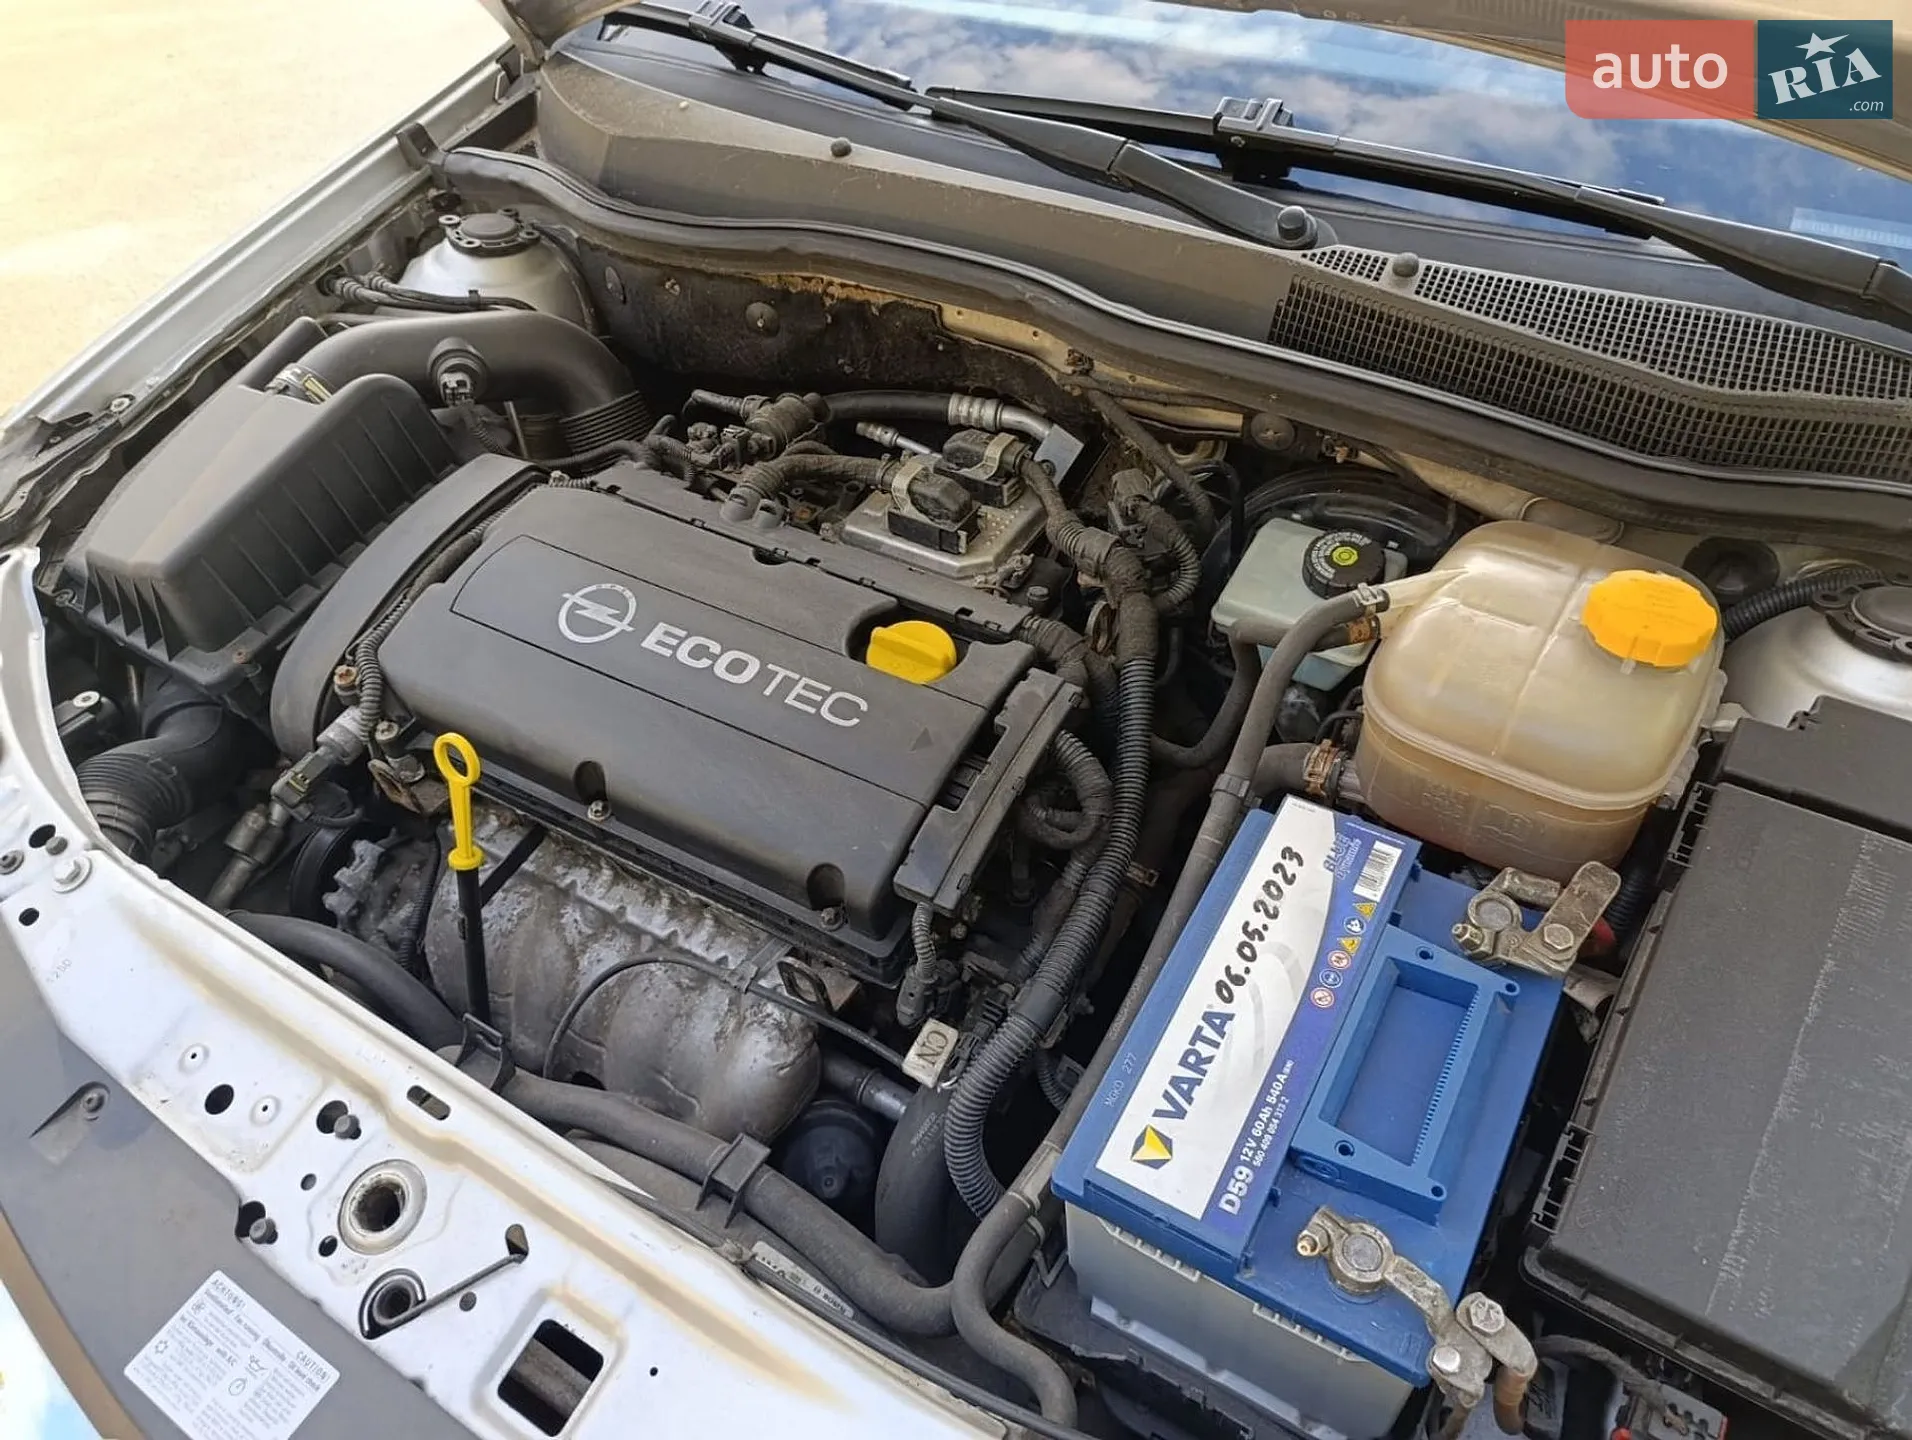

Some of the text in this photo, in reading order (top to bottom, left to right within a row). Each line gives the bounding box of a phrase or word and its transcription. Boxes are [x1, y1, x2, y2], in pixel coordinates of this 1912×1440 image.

[641, 622, 868, 727] ECOTEC
[1323, 832, 1350, 873] BLUE
[1215, 846, 1304, 1004] 06.05.2023
[1152, 1008, 1236, 1121] VARTA
[1218, 1165, 1254, 1215] D59
[1240, 1137, 1258, 1162] 12V
[1251, 1106, 1273, 1138] 60Ah
